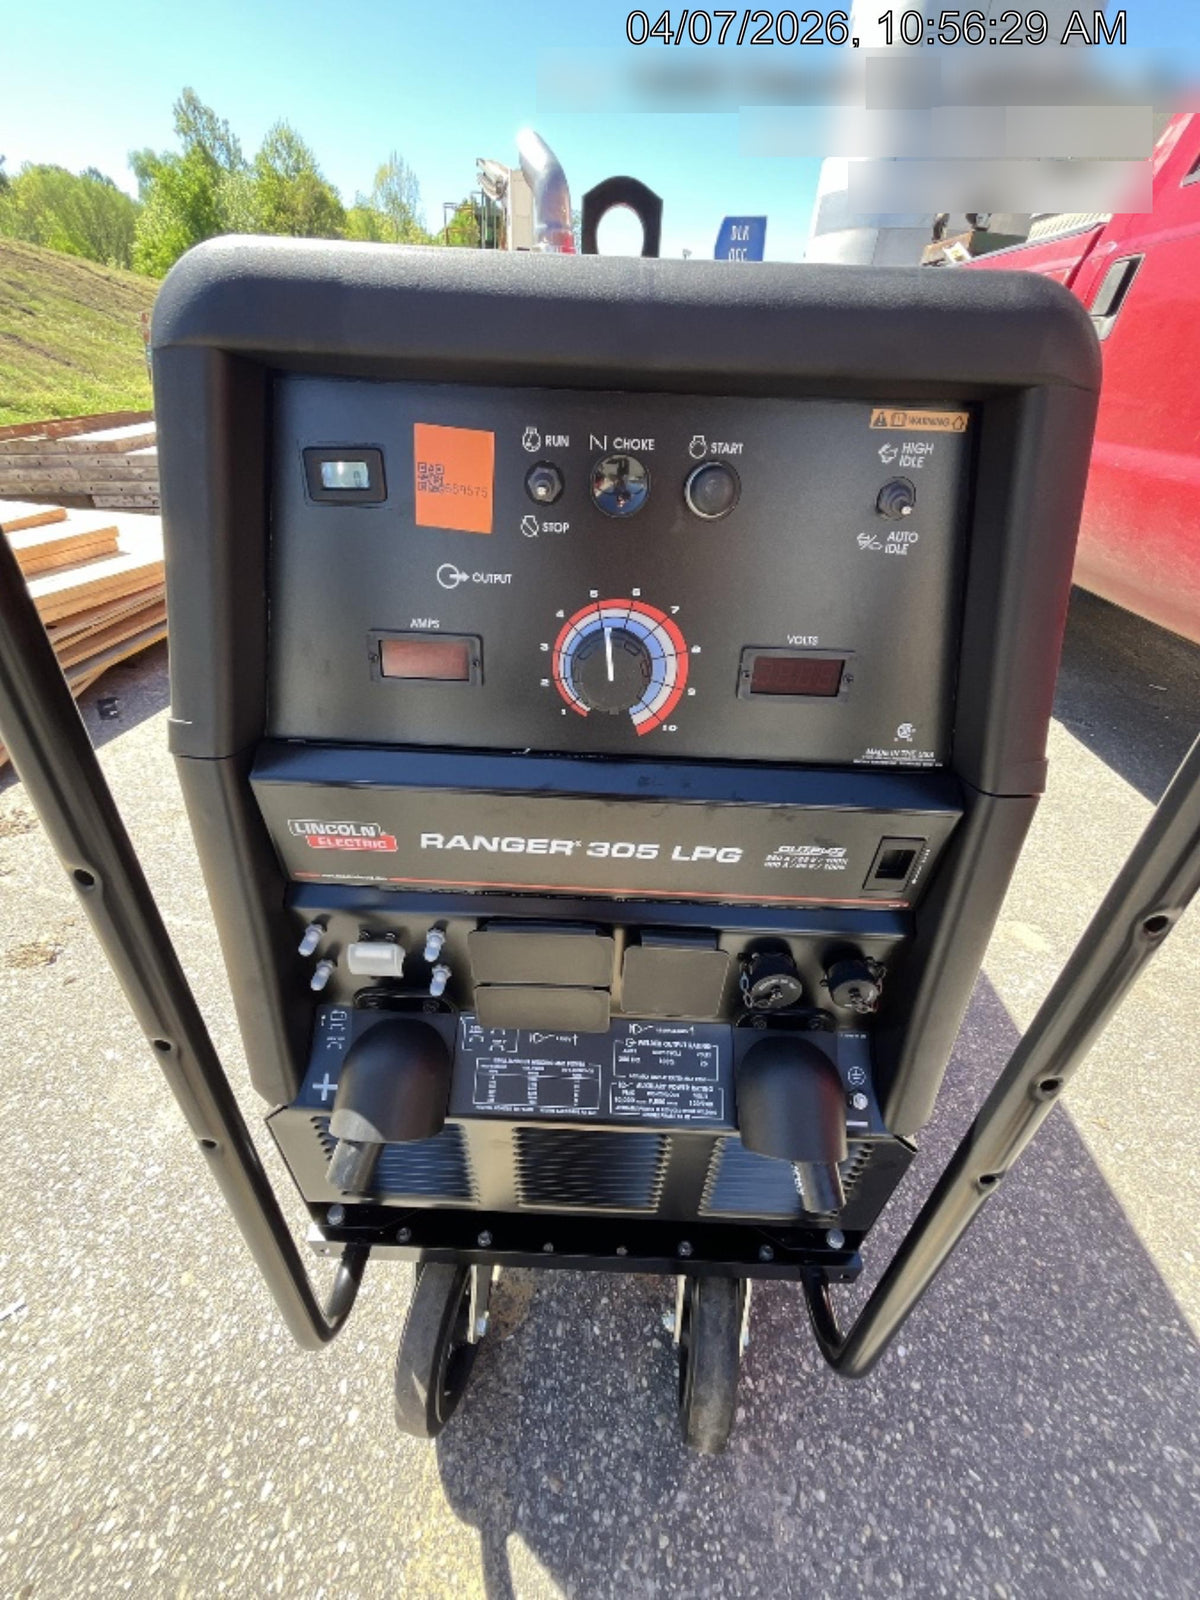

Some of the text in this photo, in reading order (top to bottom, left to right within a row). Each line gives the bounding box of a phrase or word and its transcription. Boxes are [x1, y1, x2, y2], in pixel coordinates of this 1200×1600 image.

[909, 416, 950, 427] WARNING
[545, 434, 570, 447] RUN
[613, 438, 655, 450] CHOKE
[711, 442, 744, 454] START
[902, 442, 935, 455] HIGH
[899, 456, 925, 468] IDLE
[542, 521, 570, 534] STOP
[887, 531, 919, 543] AUTO
[884, 543, 909, 555] IDLE
[472, 572, 513, 584] OUTPUT
[589, 589, 599, 598] 5
[556, 609, 564, 618] 4
[670, 605, 680, 614] 7
[410, 618, 440, 629] AMPS
[787, 634, 819, 646] VOLTS
[662, 724, 678, 732] 10
[294, 822, 375, 837] LINCOLN
[318, 836, 388, 849] ELECTRIC
[586, 842, 660, 860] 305
[671, 845, 744, 863] LPG
